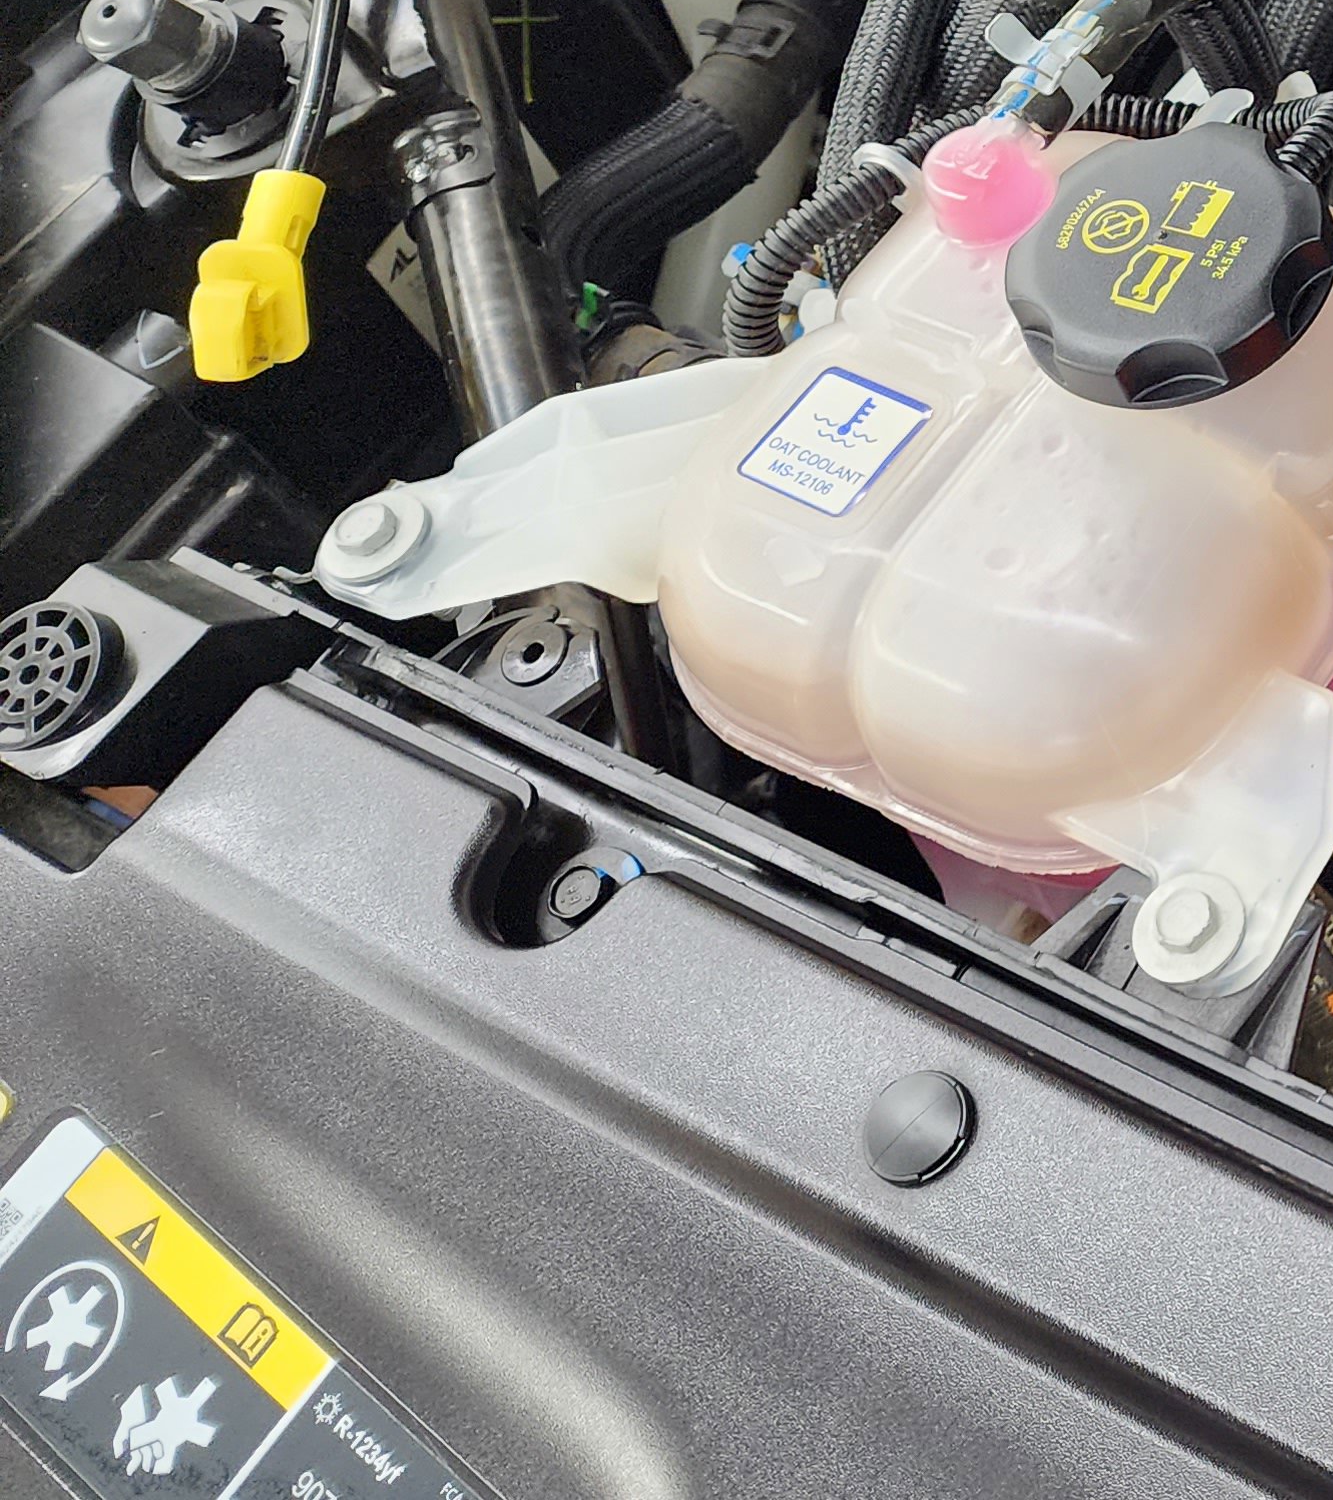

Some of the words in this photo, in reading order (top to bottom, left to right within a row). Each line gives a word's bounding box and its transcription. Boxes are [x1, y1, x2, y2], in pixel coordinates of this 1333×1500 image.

[1205, 239, 1227, 258] PSI
[1225, 235, 1249, 257] kPa
[1199, 258, 1214, 268] 5
[768, 436, 800, 457] OAT
[797, 449, 866, 486] COOLANT
[767, 458, 835, 496] MS-12106
[332, 1413, 405, 1485] R-1234yf
